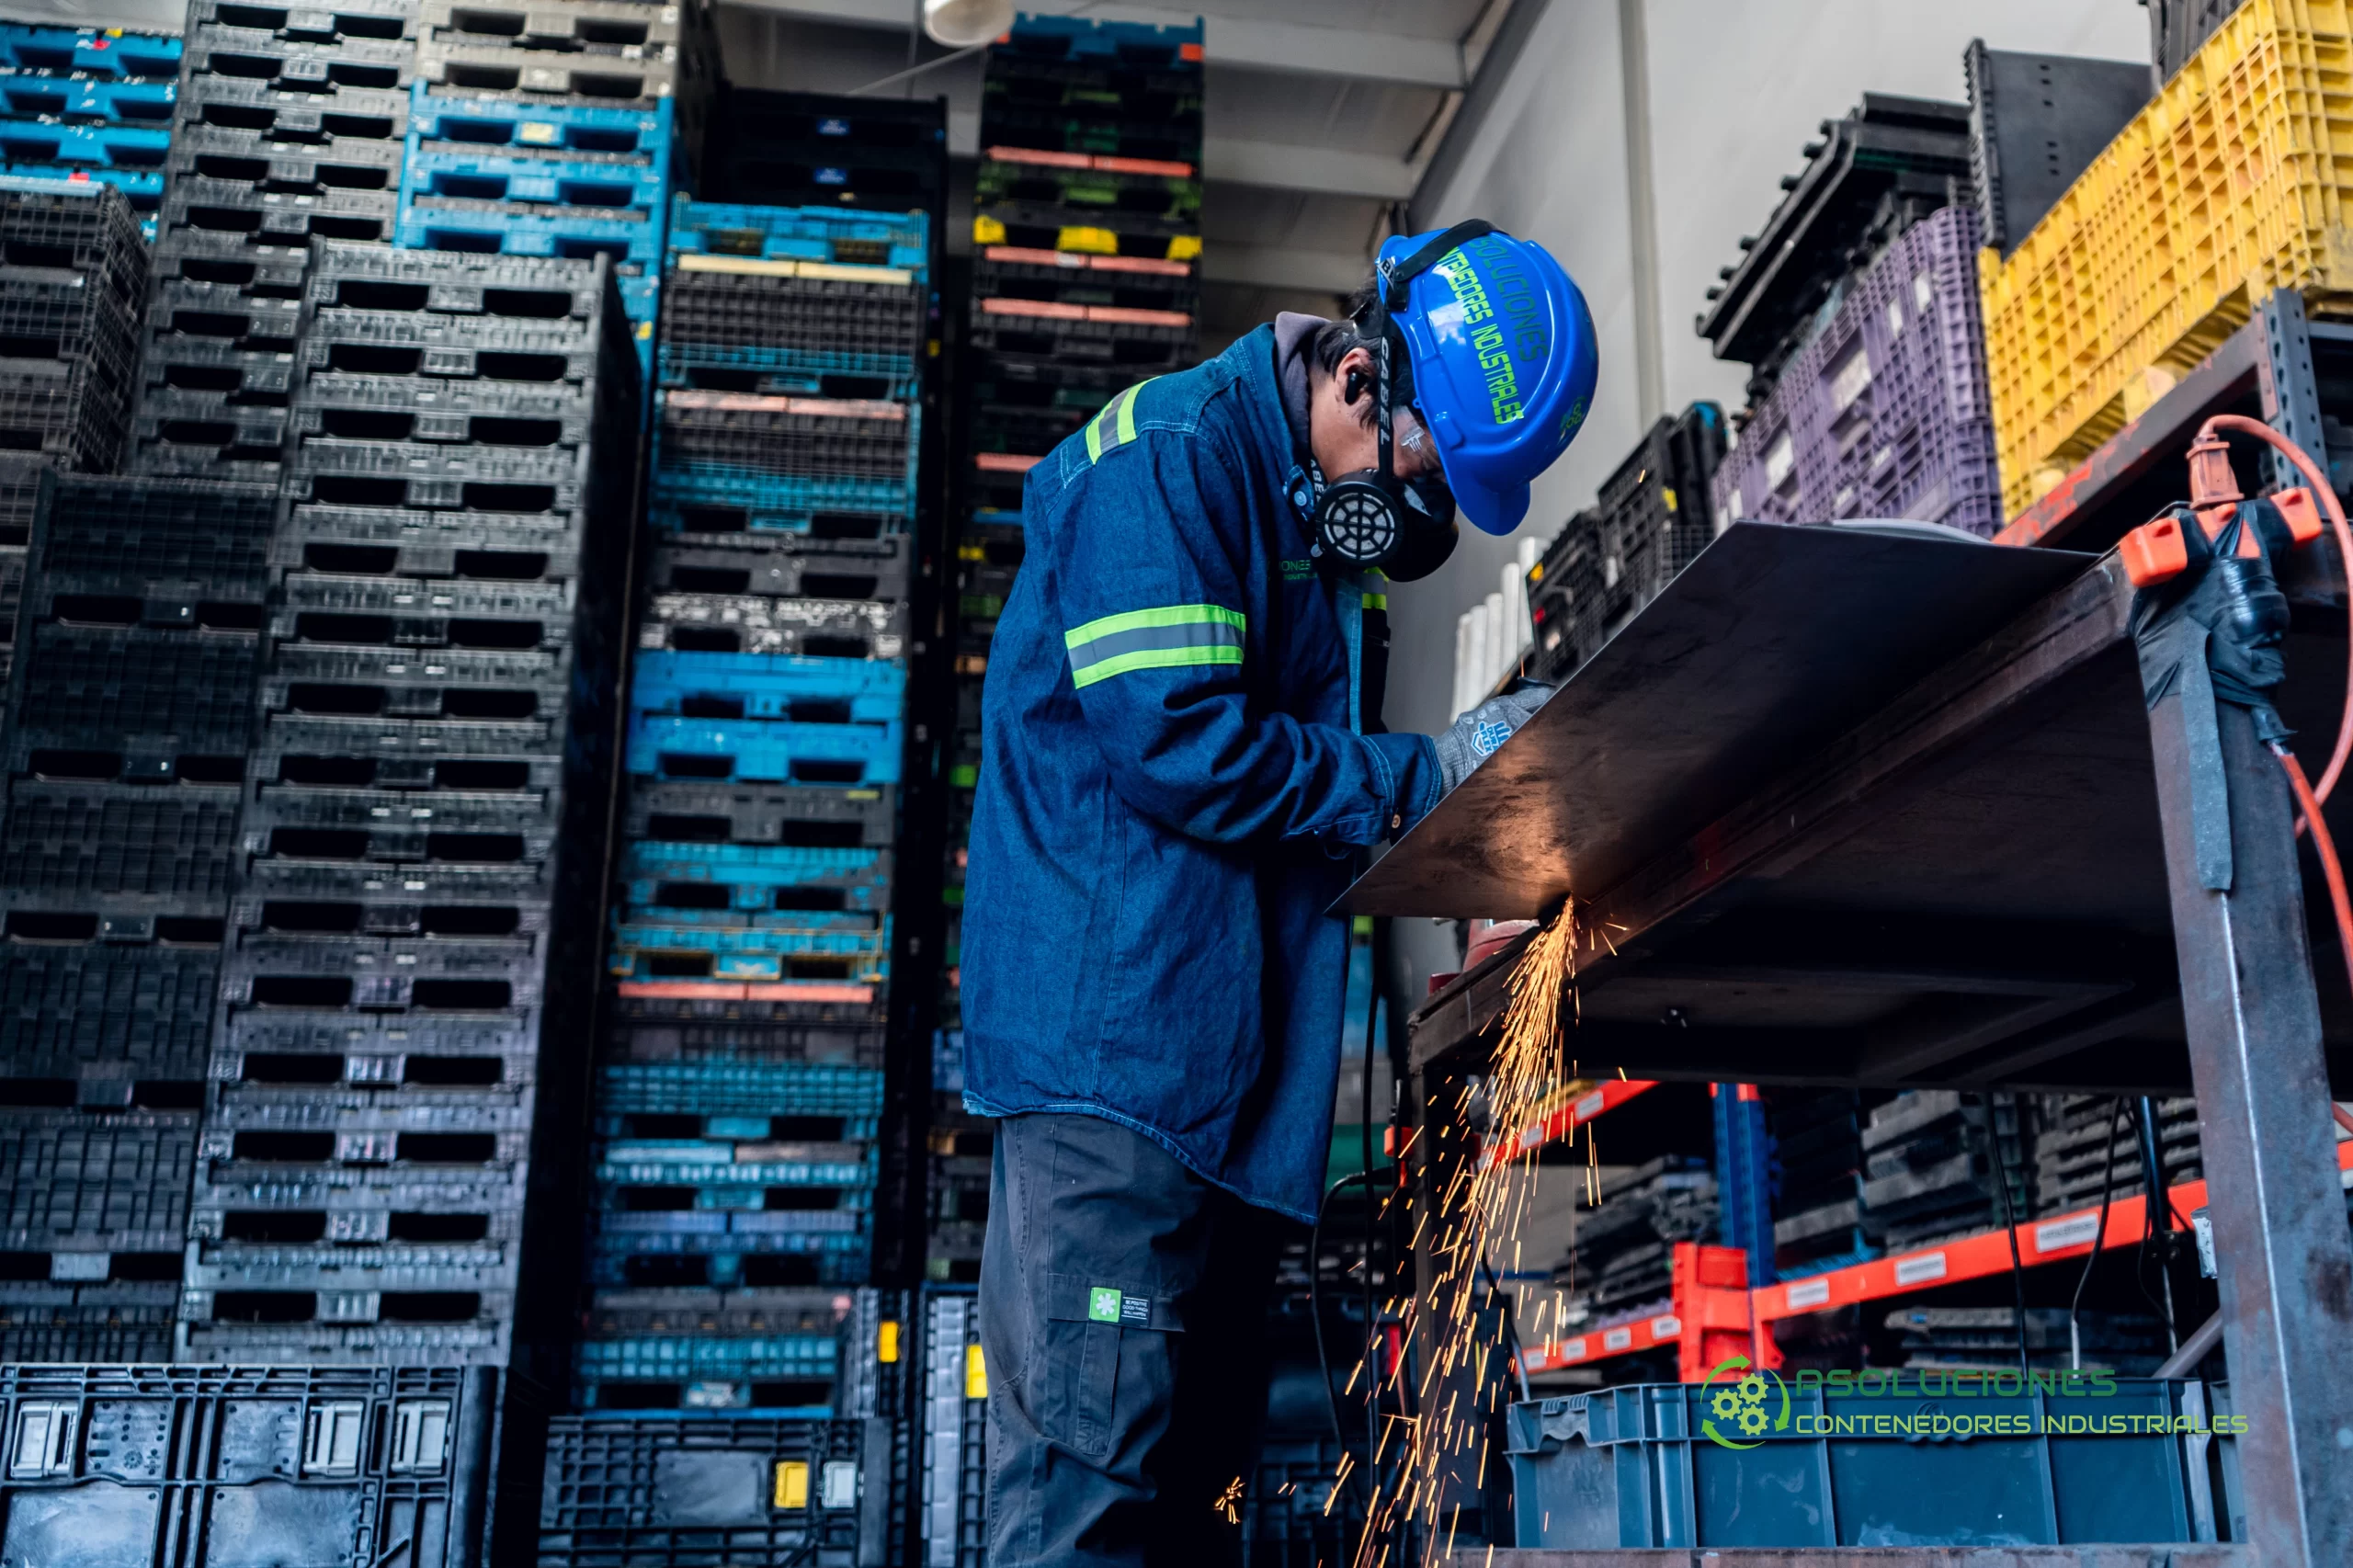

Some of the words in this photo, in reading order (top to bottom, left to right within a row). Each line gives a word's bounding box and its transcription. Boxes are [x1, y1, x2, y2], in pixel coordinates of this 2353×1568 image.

[1380, 336, 1391, 445] CABEL
[1471, 323, 1525, 425] INDUSTRIALES
[1480, 730, 1493, 753] FLEX
